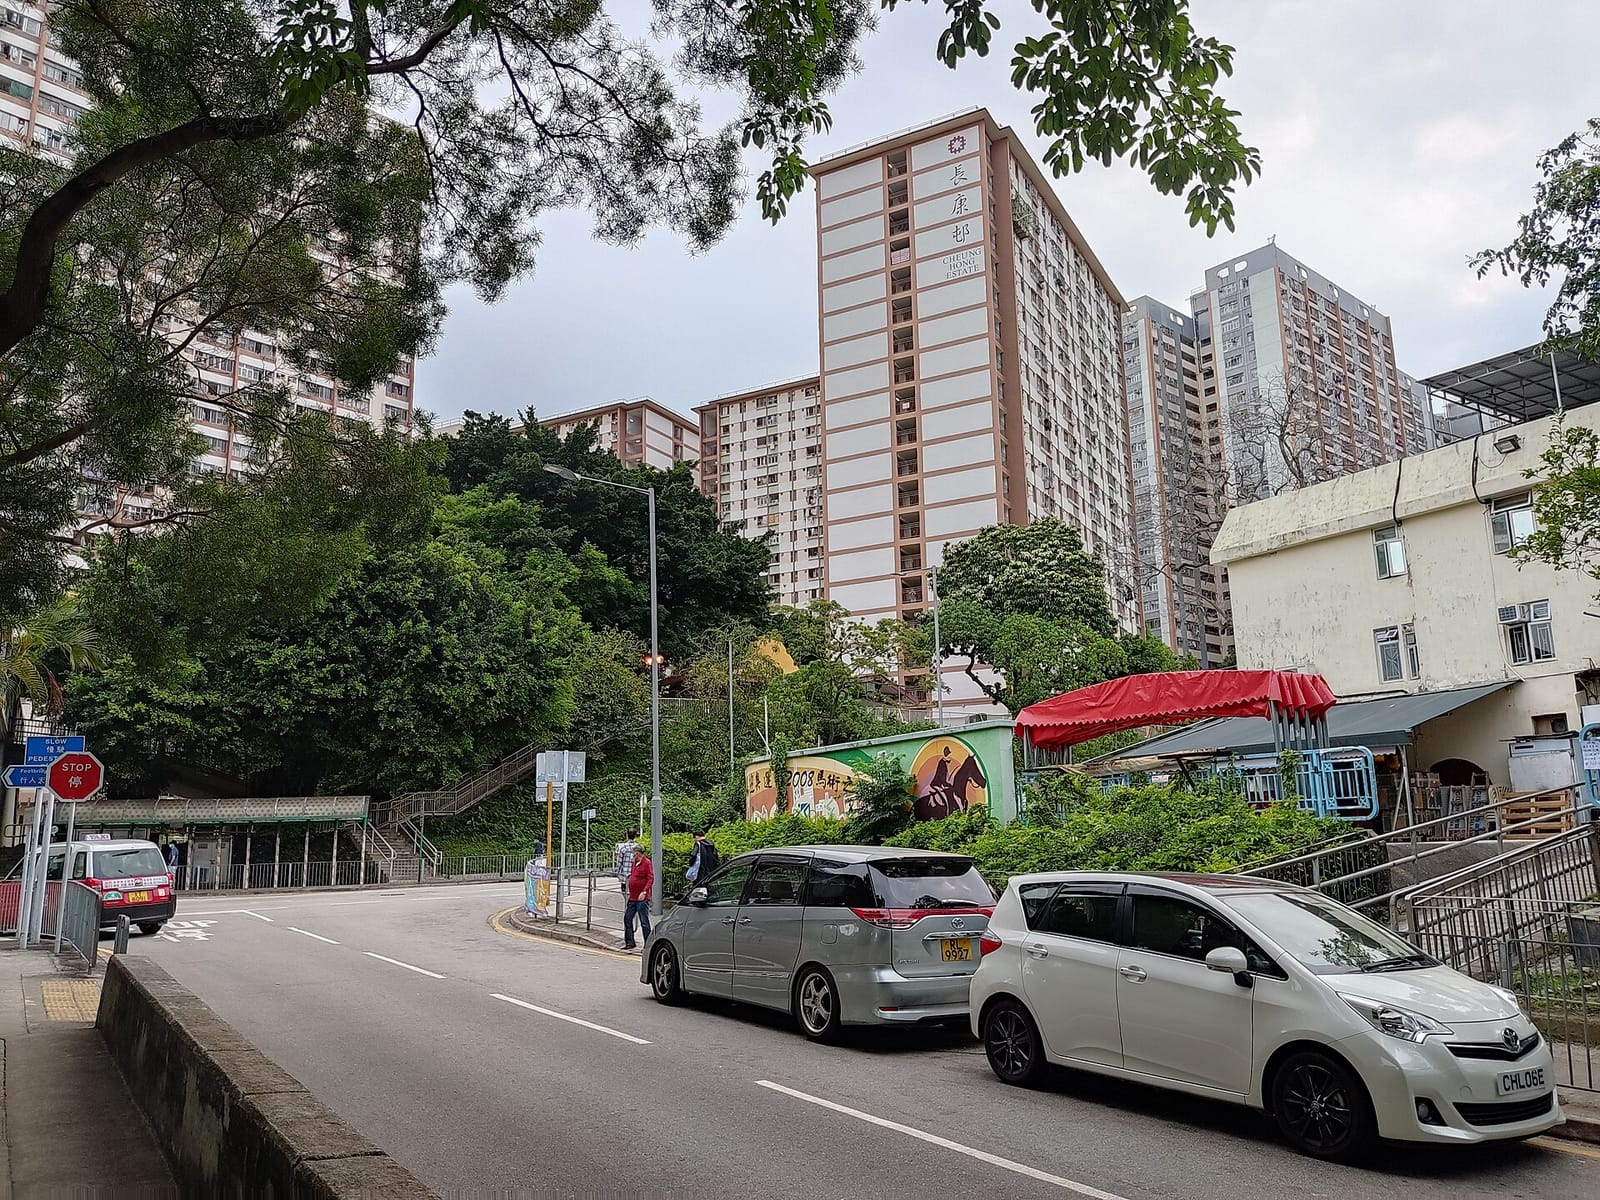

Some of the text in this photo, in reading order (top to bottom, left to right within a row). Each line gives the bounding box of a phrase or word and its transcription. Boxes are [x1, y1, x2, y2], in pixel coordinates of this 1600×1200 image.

[950, 163, 970, 243] 長康邨
[942, 248, 982, 265] CHEUNG
[949, 258, 976, 271] HONG
[946, 264, 980, 279] ESTATE
[62, 763, 92, 772] STOP
[20, 776, 46, 784] 行人天
[68, 775, 83, 788] 停
[949, 939, 963, 950] RL
[945, 949, 969, 961] 9927
